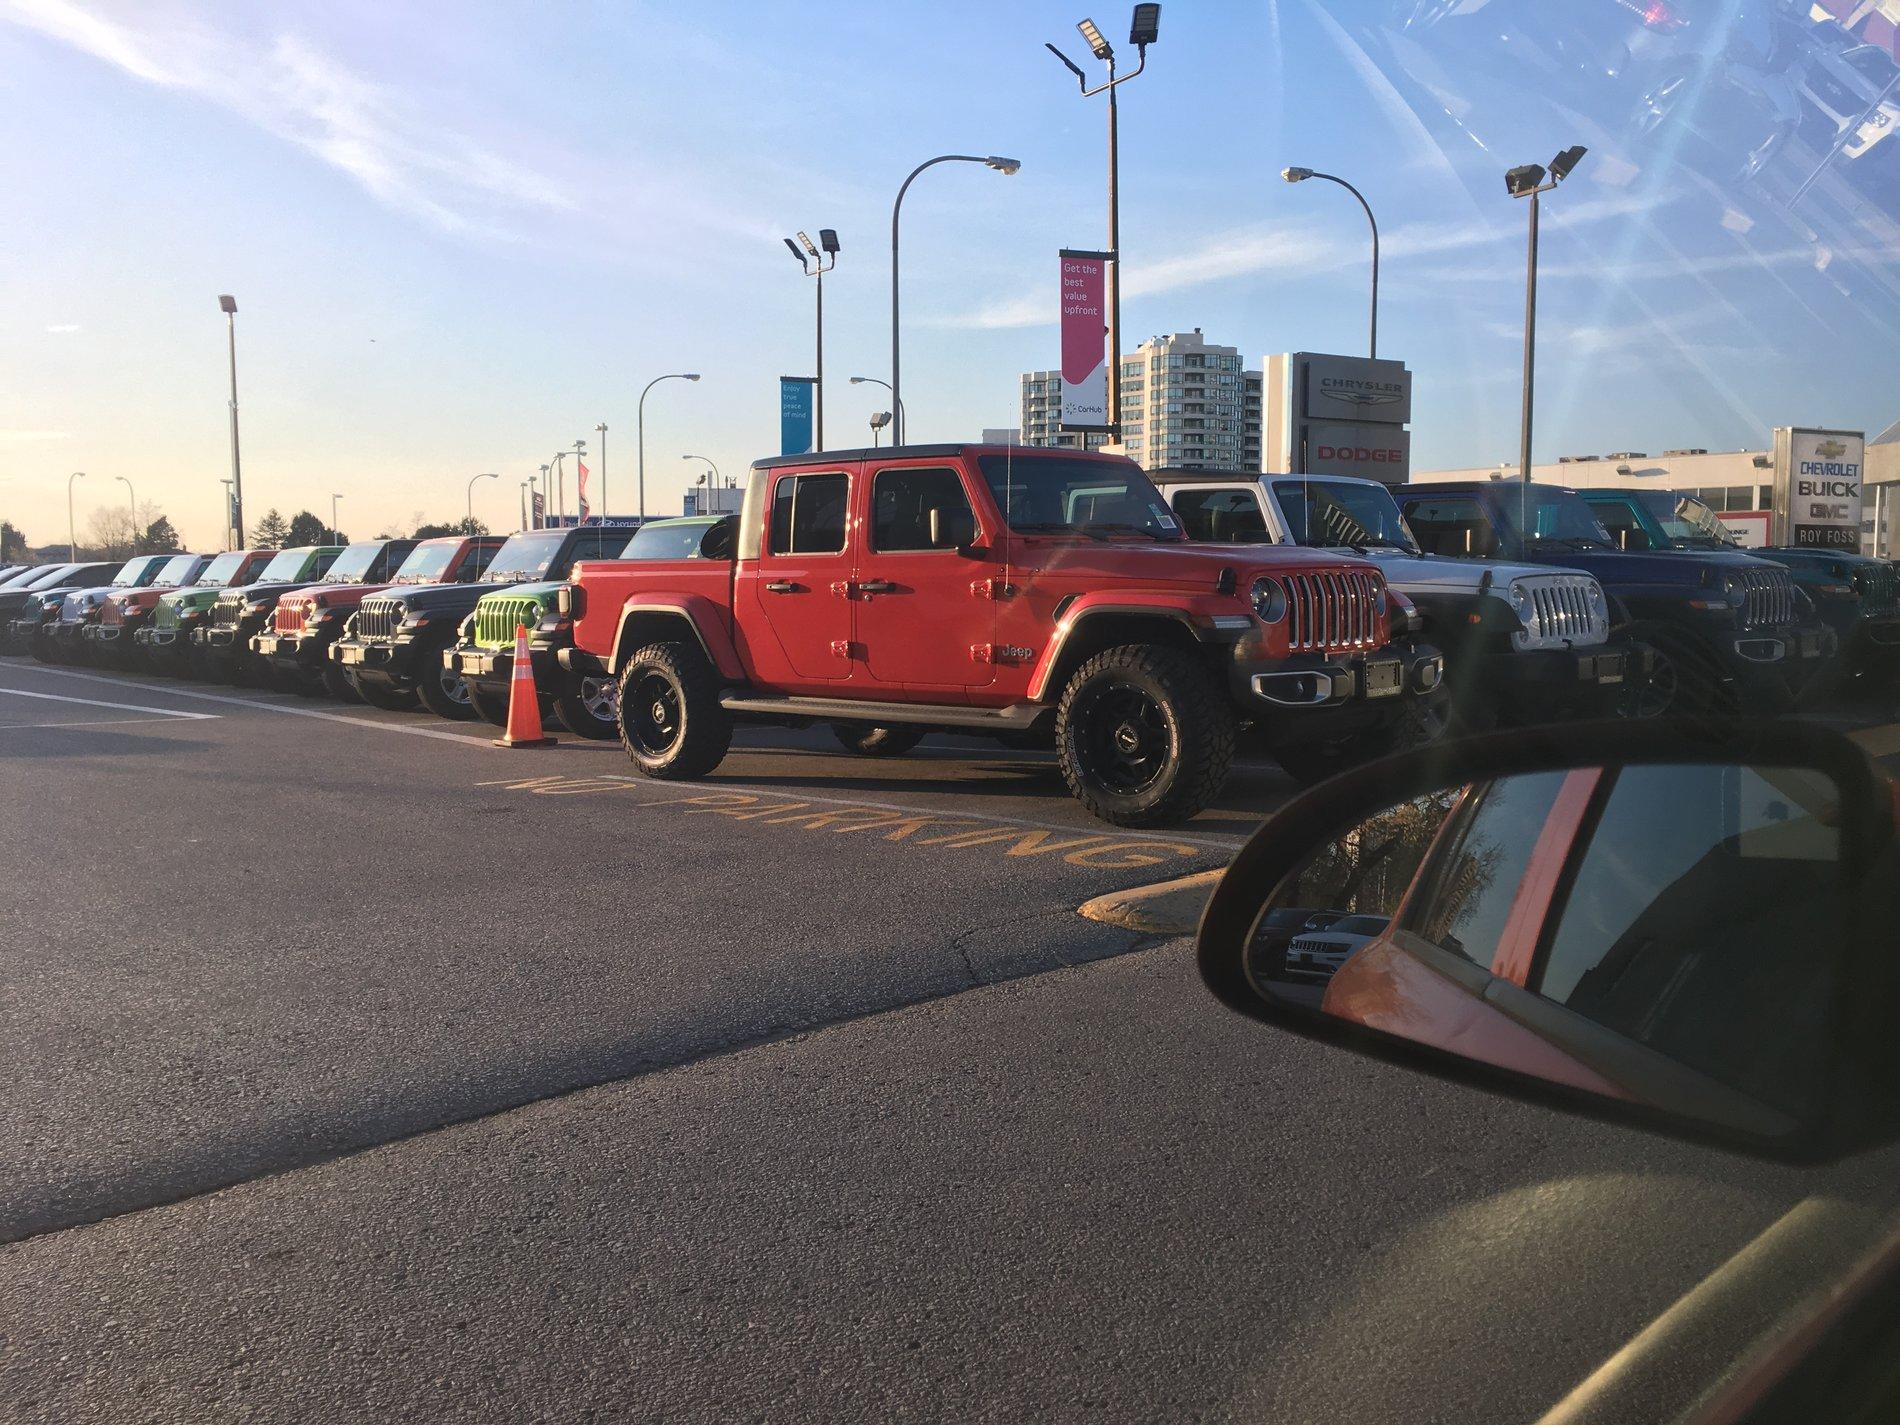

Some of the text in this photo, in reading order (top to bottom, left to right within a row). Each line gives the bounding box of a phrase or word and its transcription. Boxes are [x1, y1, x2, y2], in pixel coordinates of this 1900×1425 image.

[1064, 263, 1097, 274] Get the
[1064, 277, 1084, 287] best
[1064, 292, 1088, 301] value
[1064, 305, 1098, 315] upfront
[783, 384, 800, 393] Enjoy
[1321, 378, 1402, 392] CHRYSLER
[1077, 405, 1102, 413] CarHub
[1318, 446, 1402, 463] DODGE
[1800, 461, 1859, 477] CHEVROLET
[1798, 480, 1859, 498] BUICK
[1810, 503, 1849, 519] GMC
[1800, 529, 1855, 544] ROY FOSS
[1002, 644, 1033, 659] Jeep
[474, 775, 1200, 869] NO PARKING
